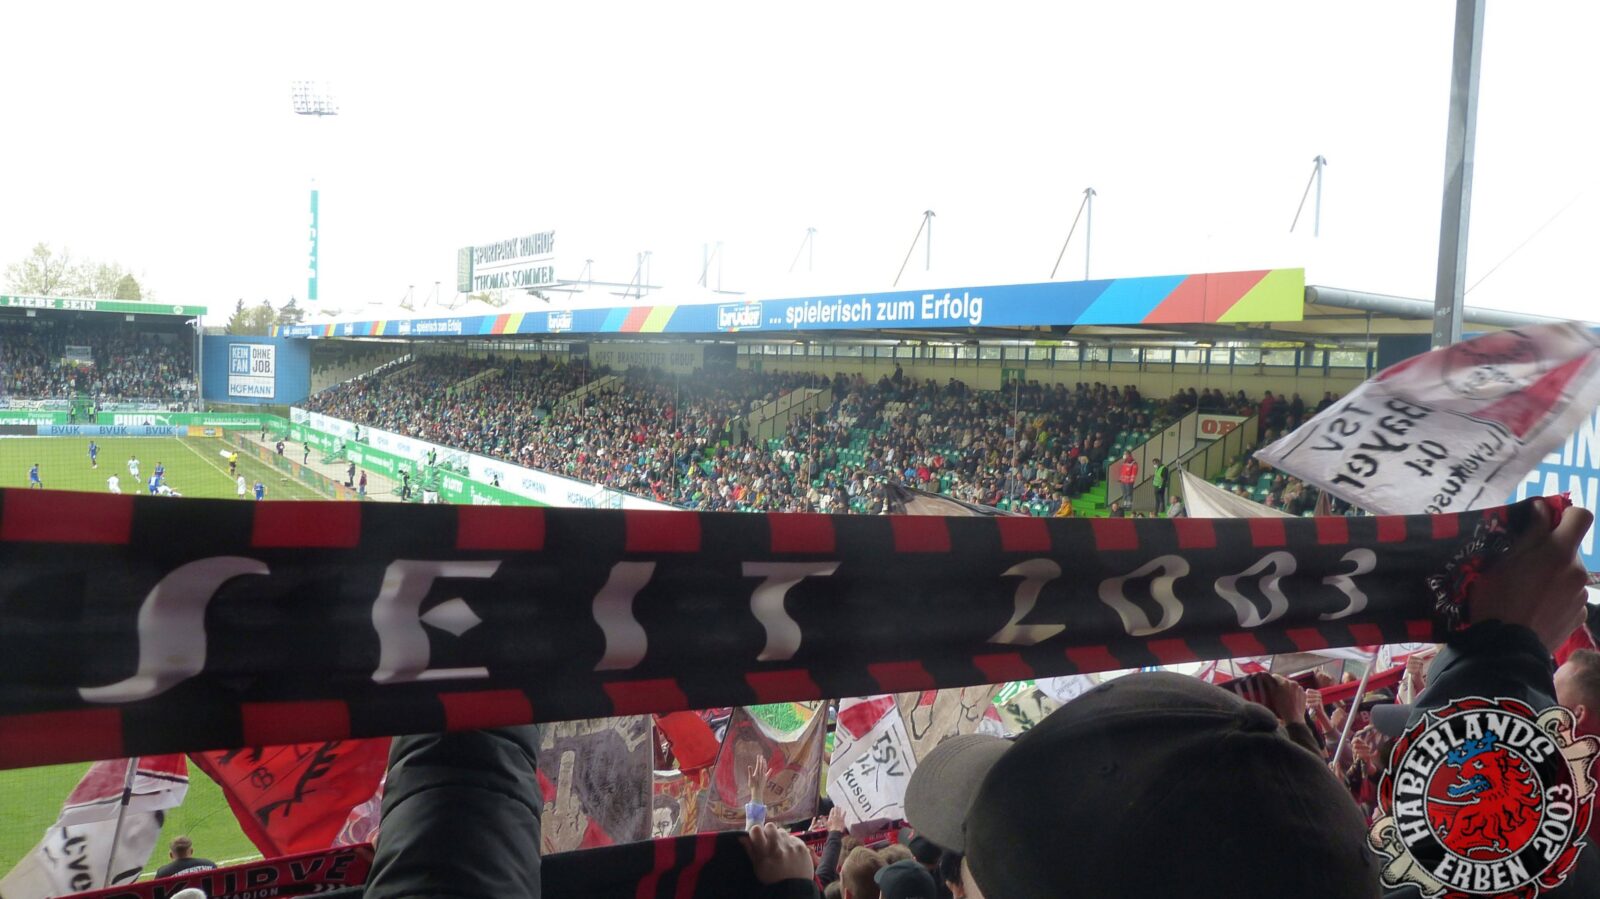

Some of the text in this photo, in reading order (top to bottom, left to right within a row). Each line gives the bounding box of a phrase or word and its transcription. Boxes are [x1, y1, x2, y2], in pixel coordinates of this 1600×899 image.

[474, 265, 554, 291] THOMAS SOMMER
[8, 296, 97, 311] LIEBE SEIN
[785, 298, 870, 328] spielerisch
[876, 303, 915, 321] zum
[921, 292, 983, 326] Erfolg
[232, 347, 271, 359] KEIN OHNE
[232, 359, 248, 372] FAN
[230, 384, 271, 395] HOFMANN
[77, 556, 842, 701] SEIT
[986, 547, 1378, 646] 2003
